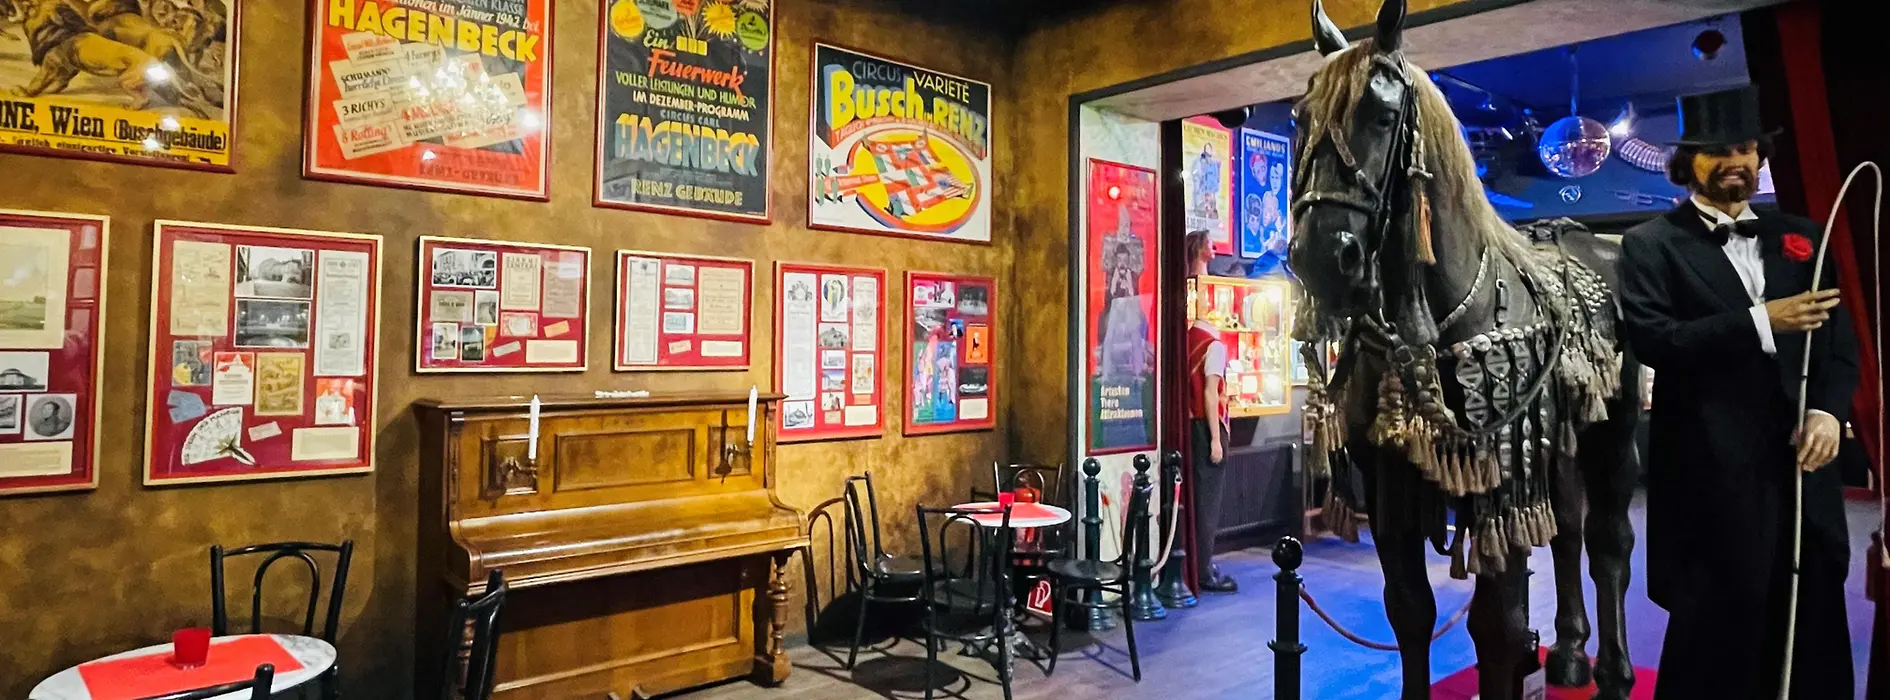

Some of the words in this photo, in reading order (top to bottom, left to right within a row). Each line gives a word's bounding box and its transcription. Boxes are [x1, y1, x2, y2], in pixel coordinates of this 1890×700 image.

[328, 0, 540, 63] HAGENBECK
[439, 3, 455, 15] im
[456, 4, 494, 22] Jänner
[496, 12, 520, 28] 1942
[643, 30, 669, 50] Ein
[647, 49, 745, 105] Feuerwerk
[852, 60, 901, 83] CIRCUS
[615, 71, 649, 88] VOLLER
[650, 79, 695, 98] LEISTUNGEN
[697, 86, 717, 101] UND
[719, 91, 757, 110] HUMOR
[632, 90, 648, 105] IM
[649, 93, 750, 122] DEZEMBER-PROGRAMM
[50, 105, 104, 138] Wien
[342, 100, 349, 116] 3
[660, 109, 696, 123] CIRCUS
[697, 115, 721, 128] CARL
[830, 69, 924, 131] Busch
[933, 96, 988, 149] RENZ
[614, 112, 760, 178] HAGENBECK
[631, 178, 673, 198] RENZ
